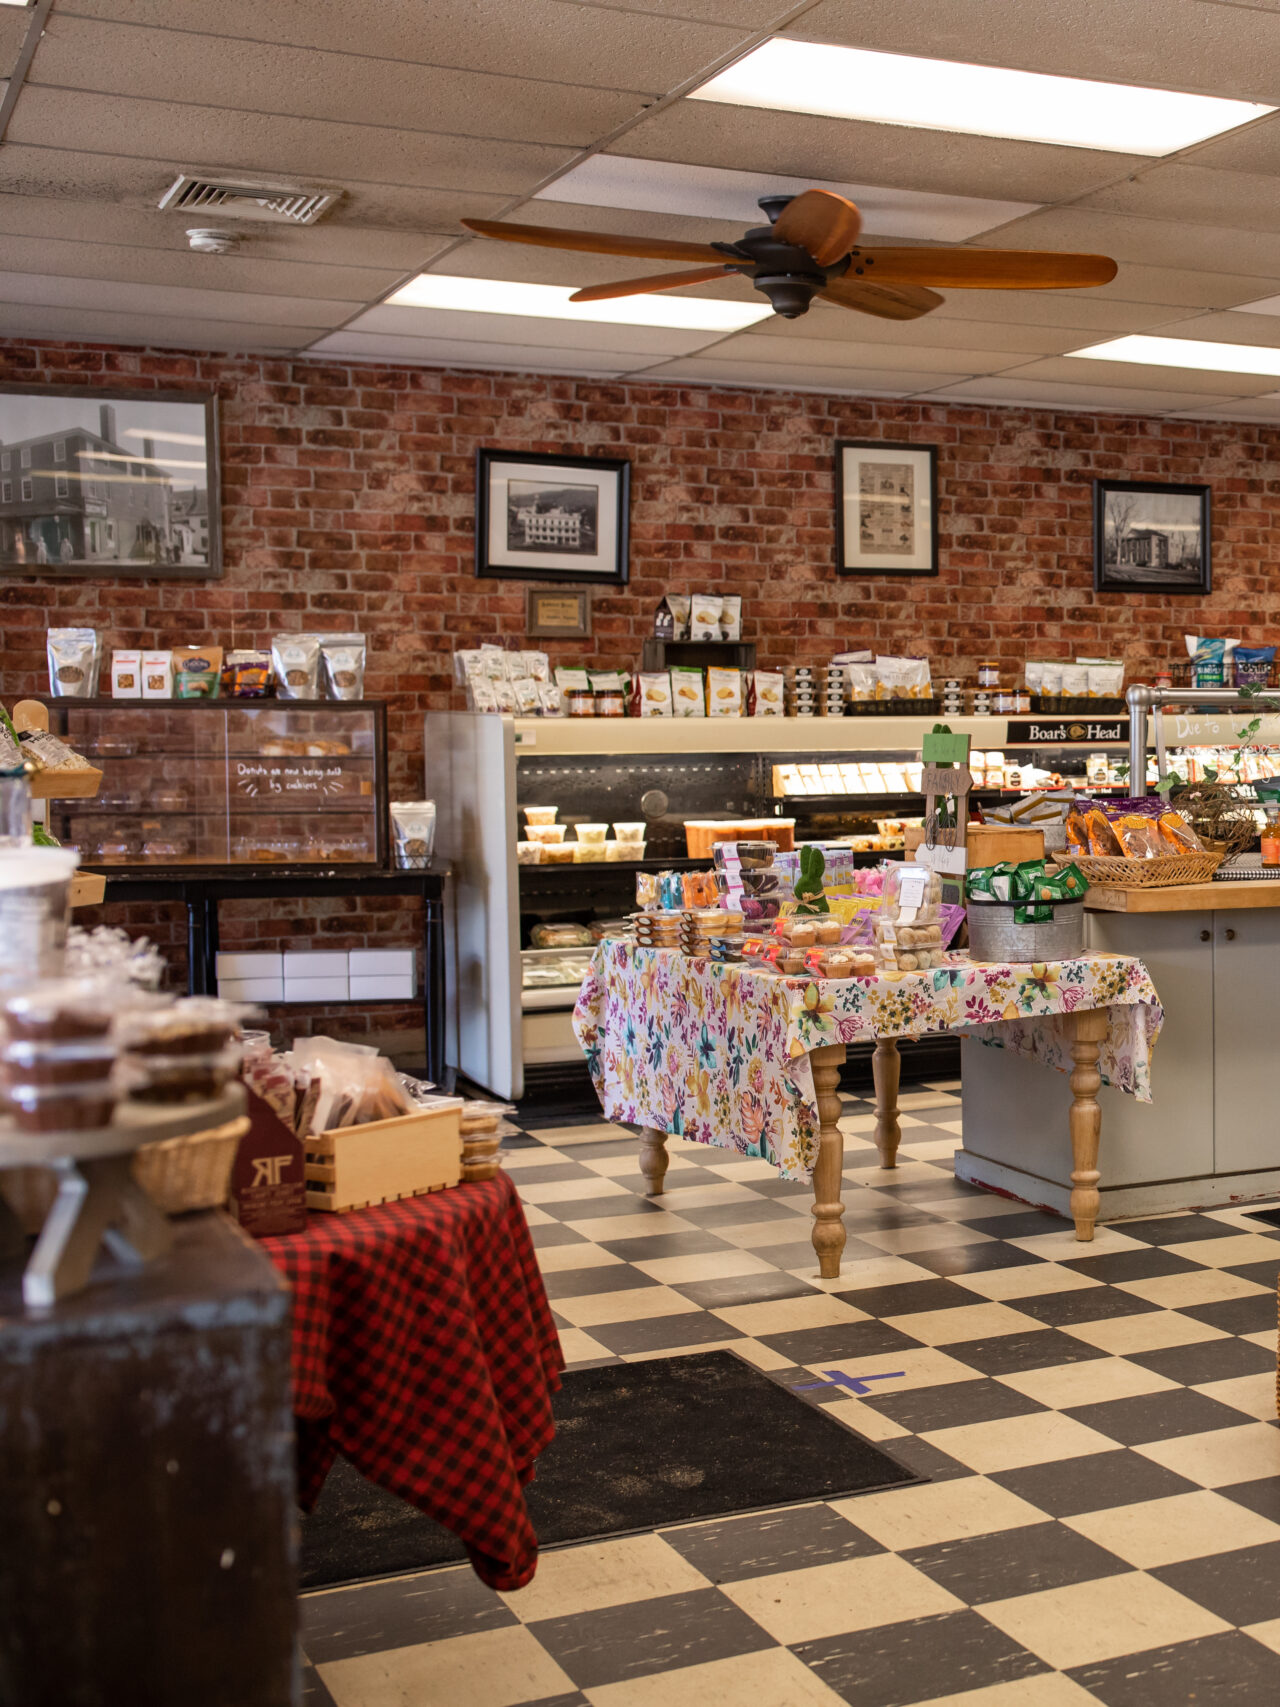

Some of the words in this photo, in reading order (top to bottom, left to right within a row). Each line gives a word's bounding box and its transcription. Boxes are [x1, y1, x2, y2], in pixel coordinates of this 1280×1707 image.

[1029, 724, 1066, 740] Boar's
[1086, 724, 1121, 740] Head
[1176, 716, 1201, 739] Due
[1204, 712, 1220, 734] to
[237, 763, 267, 776] Donuts
[303, 767, 323, 780] being
[270, 779, 282, 793] by
